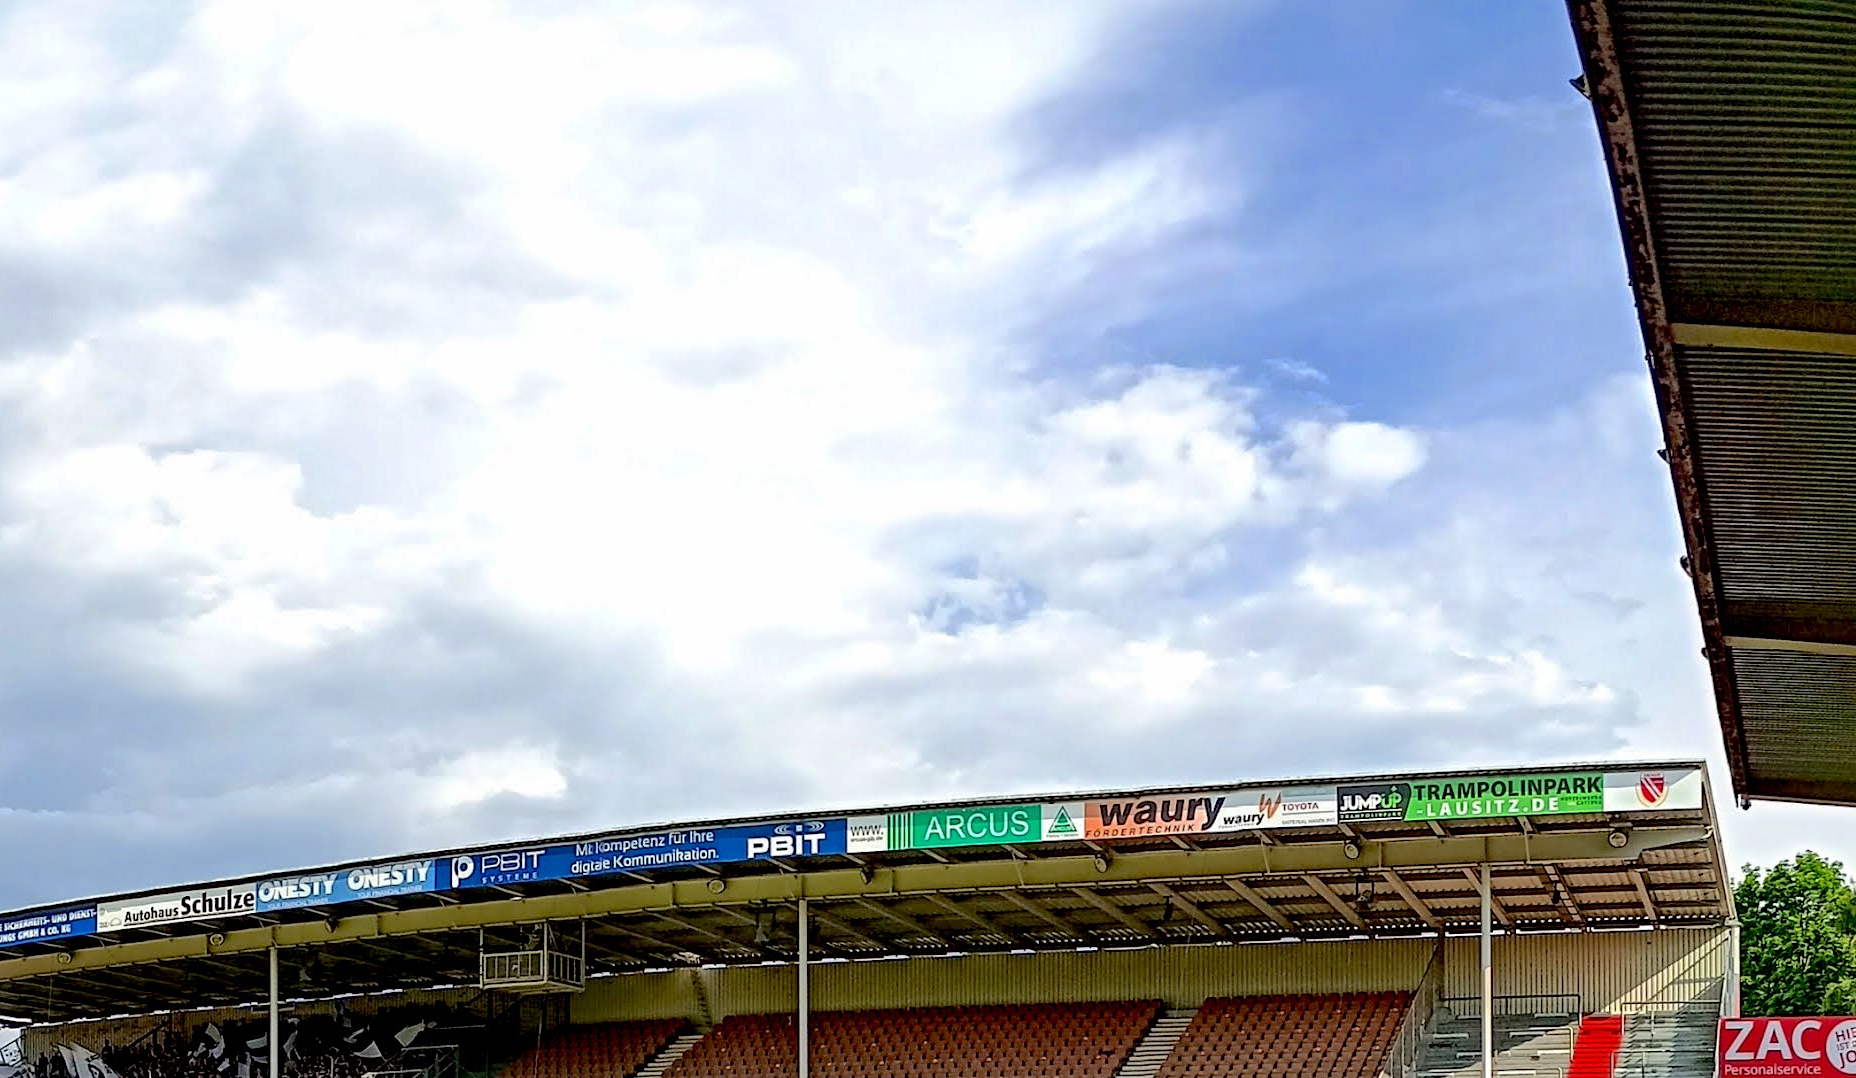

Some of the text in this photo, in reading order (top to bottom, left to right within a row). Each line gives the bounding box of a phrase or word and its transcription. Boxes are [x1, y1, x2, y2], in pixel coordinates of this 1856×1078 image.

[1414, 776, 1603, 799] TRAMPOLINPARK
[1099, 797, 1226, 831] waury
[1223, 811, 1265, 826] waury
[1282, 802, 1319, 813] TOYOTA
[850, 824, 885, 838] www.
[925, 810, 1029, 841] ARCUS
[1085, 823, 1196, 839] FÖRDERTECHNIK
[667, 830, 714, 846] für Ihre
[481, 850, 546, 873] PBIT
[347, 860, 433, 890] ONESTY
[259, 873, 338, 903] ONESTY
[124, 889, 255, 923] Autohaus Schulze
[52, 914, 68, 923] UND
[1725, 1020, 1823, 1060] ZAC
[1724, 1063, 1821, 1076] Personalservice
